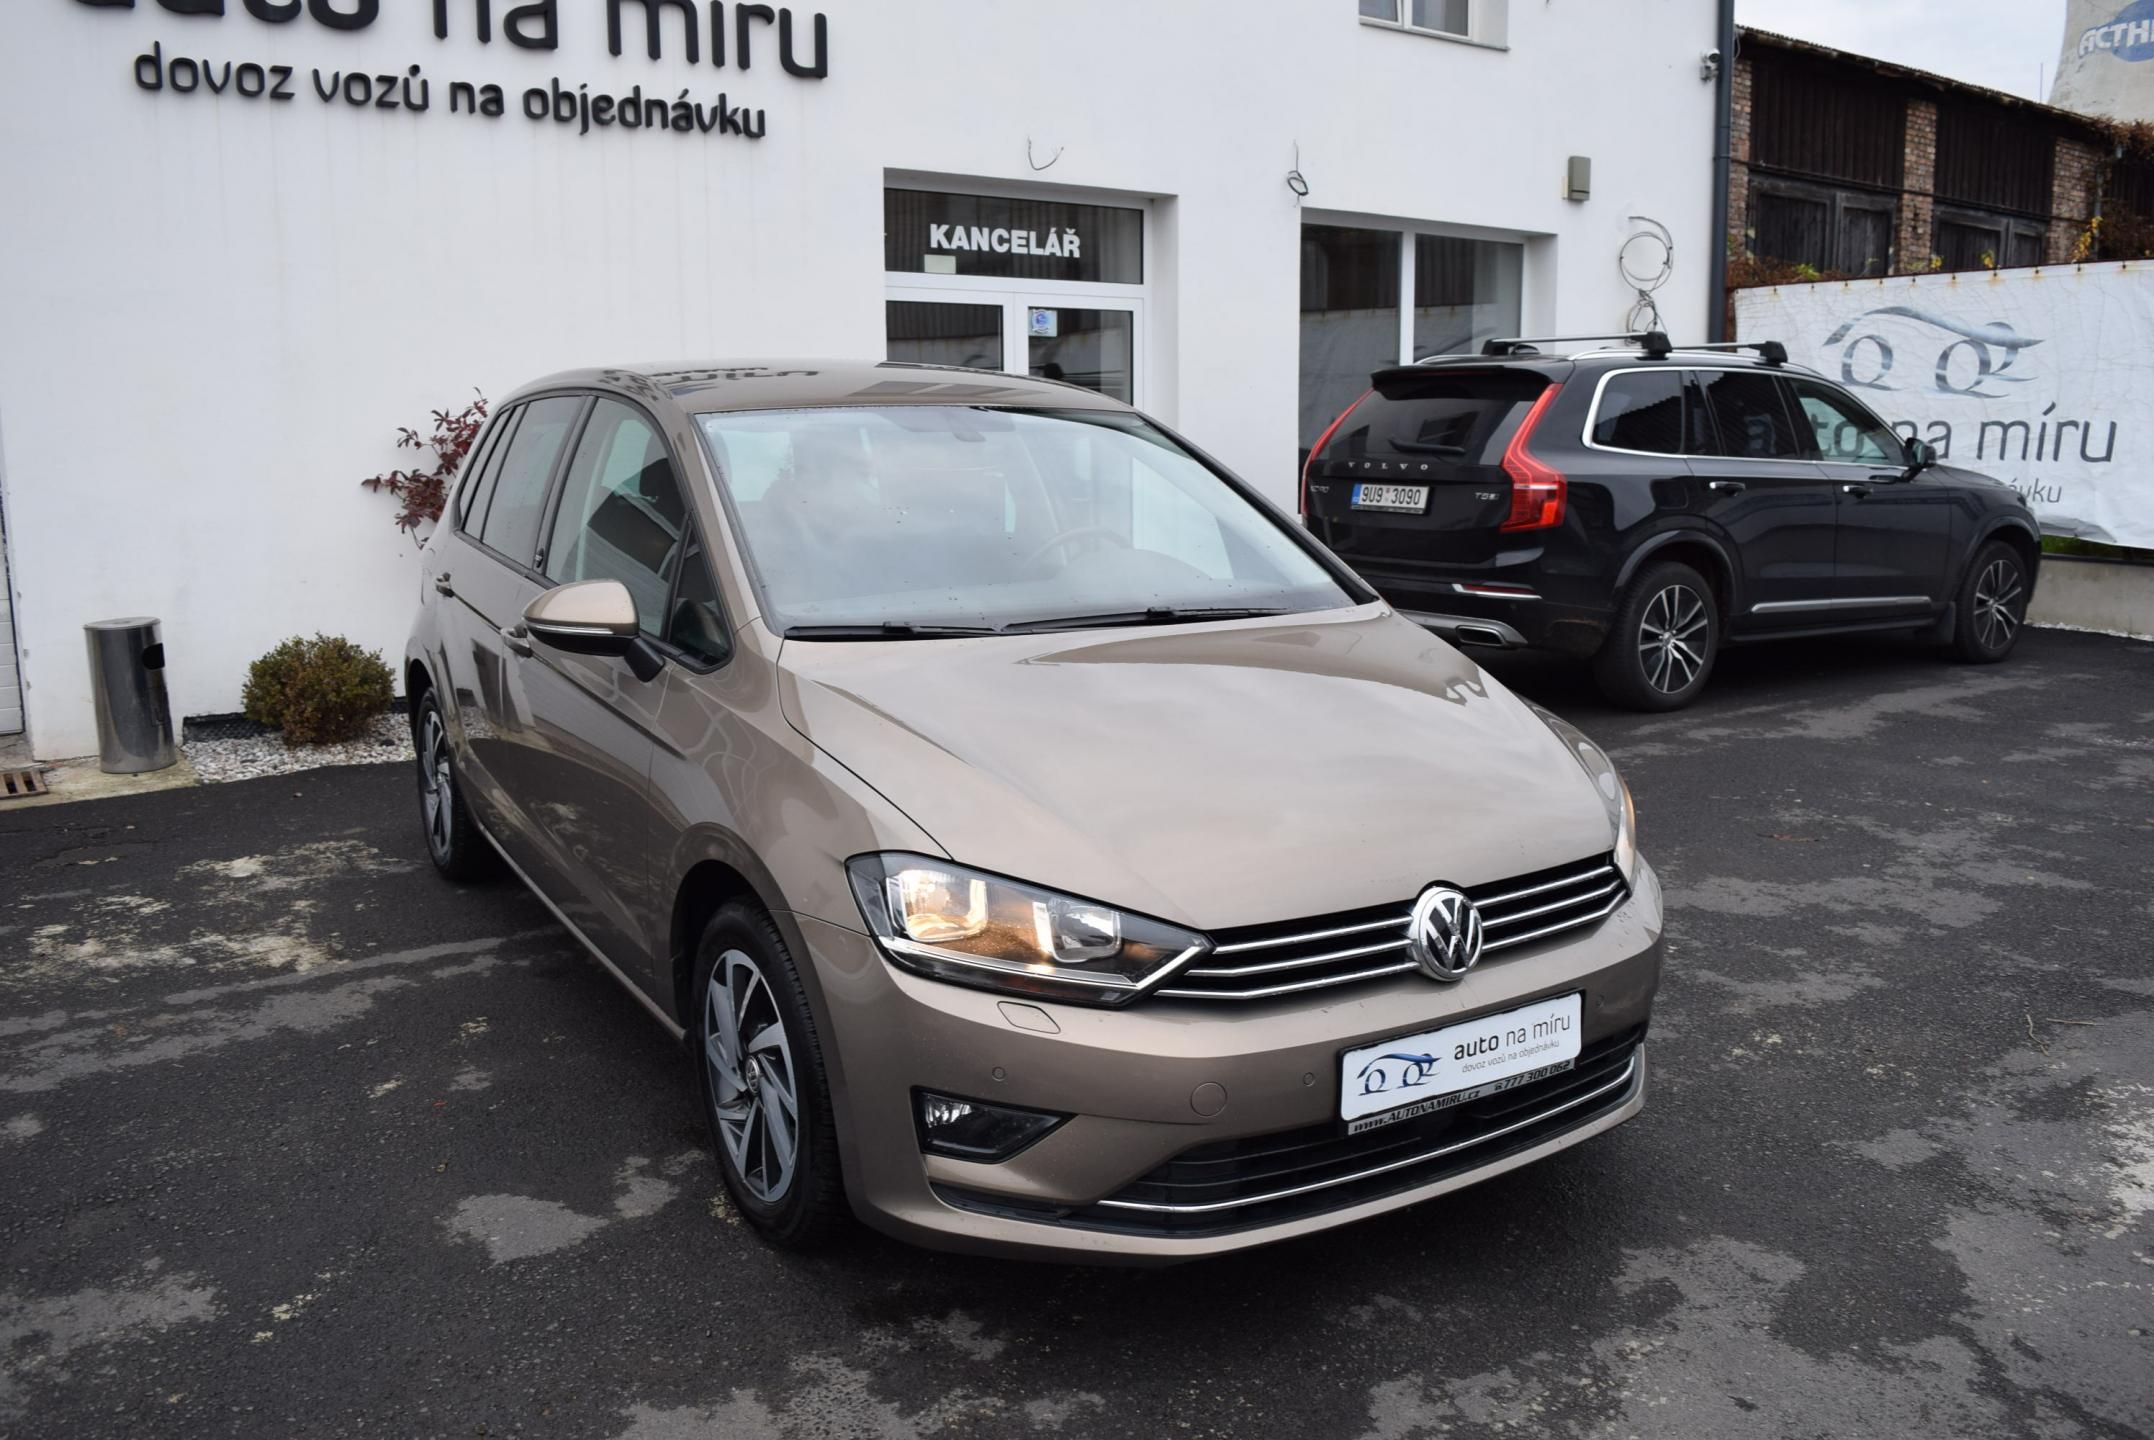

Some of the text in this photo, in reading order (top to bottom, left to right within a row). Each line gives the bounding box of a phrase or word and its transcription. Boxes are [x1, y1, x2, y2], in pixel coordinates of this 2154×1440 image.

[2079, 19, 2154, 58] ACTH
[134, 40, 766, 138] dovoz vozů na objednávku
[930, 223, 1081, 258] KANCELÁŘ
[1976, 401, 2117, 463] míru
[1348, 461, 1428, 471] VOLVO
[1361, 486, 1384, 503] 9U9
[1391, 488, 1421, 505] 3090
[1454, 1013, 1571, 1061] auto na míru
[1462, 1061, 1486, 1073] dovoz
[1508, 1051, 1518, 1061] na
[1504, 1076, 1524, 1089] 777
[1527, 1068, 1548, 1082] 300
[1549, 1060, 1571, 1074] 062
